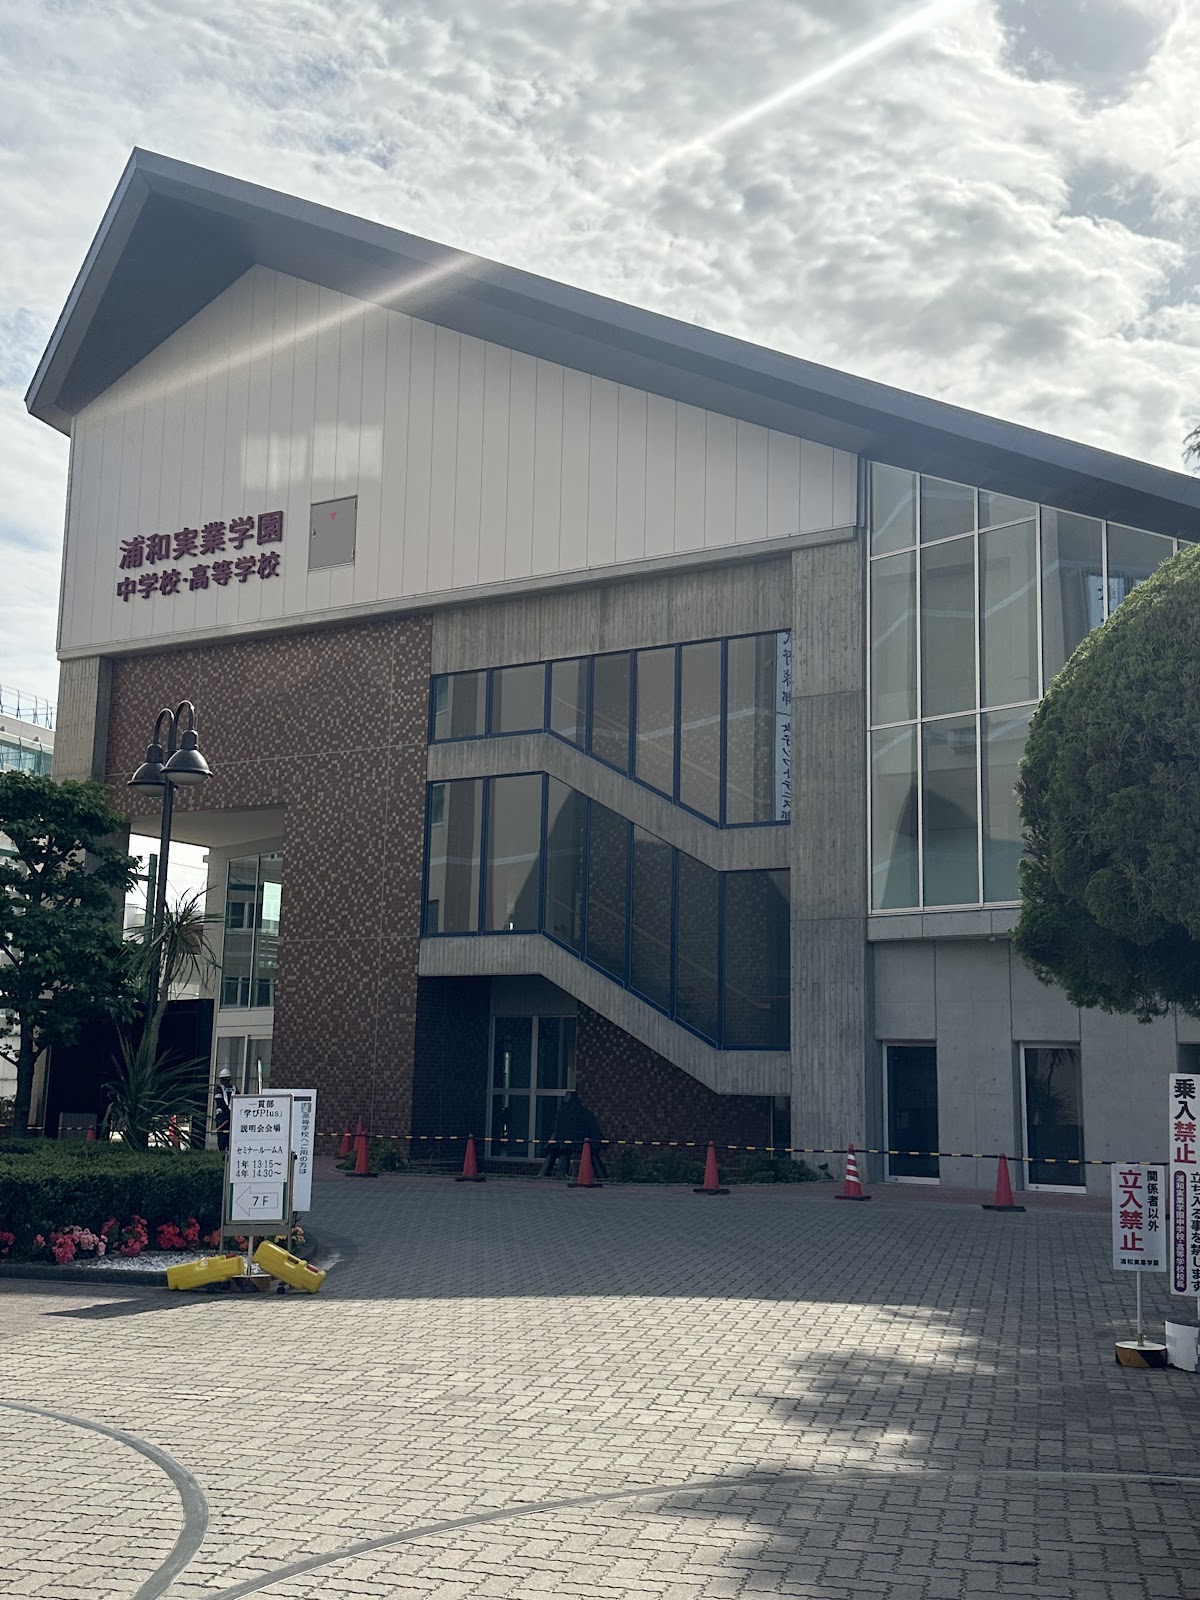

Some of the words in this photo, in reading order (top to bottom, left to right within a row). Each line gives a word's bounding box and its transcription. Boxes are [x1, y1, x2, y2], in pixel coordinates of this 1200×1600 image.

[119, 510, 283, 569] 浦和実業学園
[117, 551, 281, 602] 中学校・高等学校
[248, 1100, 275, 1108] 一貫部
[240, 1124, 281, 1133] 説明会会場
[1174, 1078, 1197, 1164] 乗入禁止
[236, 1146, 283, 1155] セミナールームA
[236, 1160, 249, 1169] 1年
[235, 1169, 249, 1178] 4年
[1119, 1169, 1144, 1251] 立入禁止
[1147, 1170, 1159, 1232] 関係者以外
